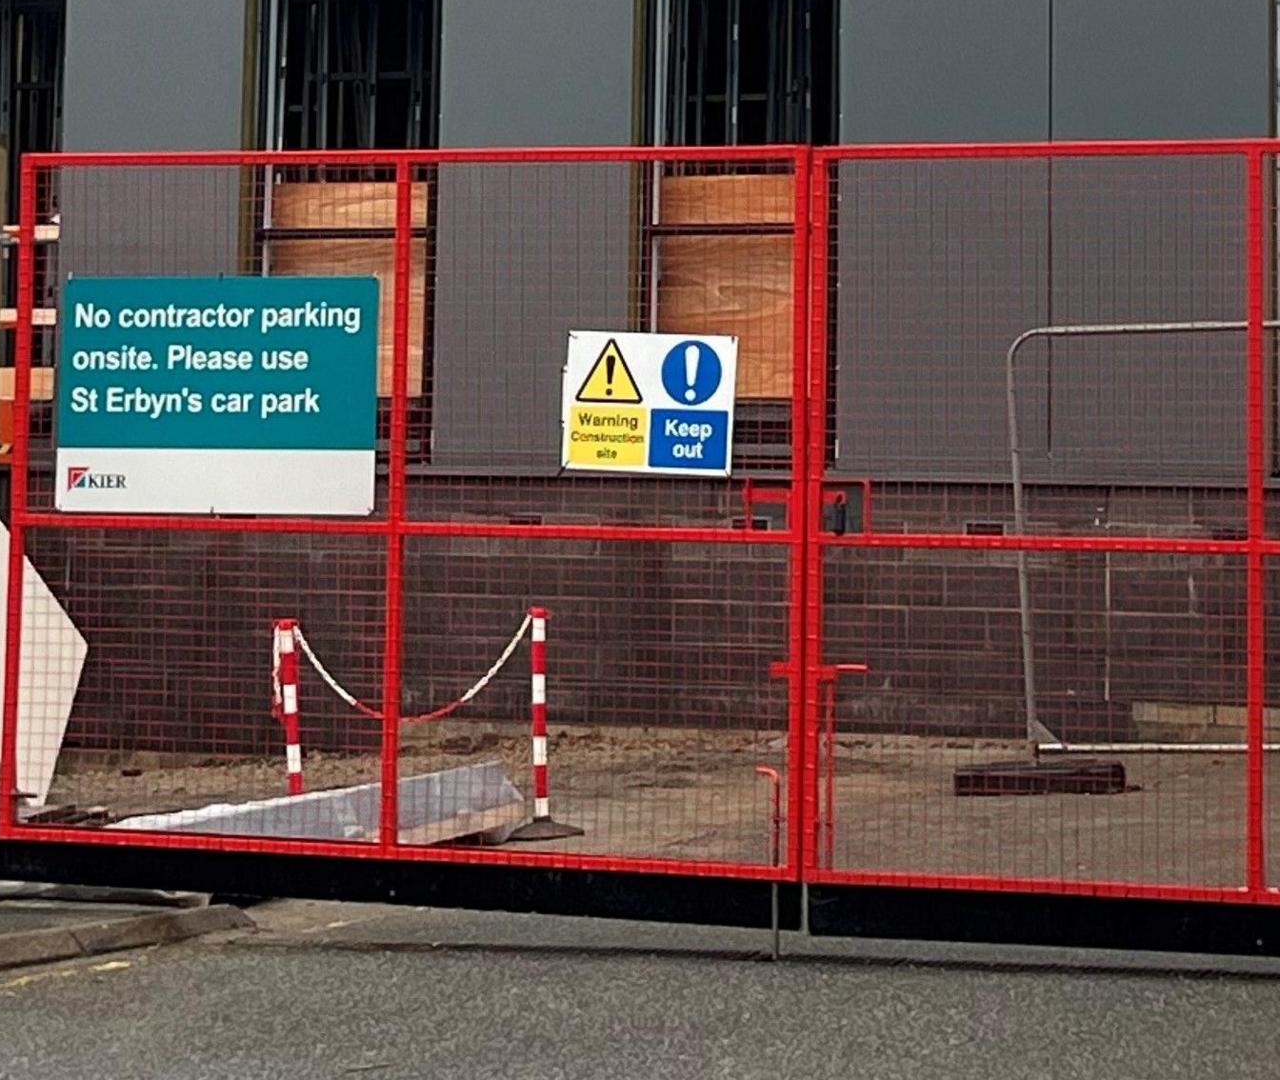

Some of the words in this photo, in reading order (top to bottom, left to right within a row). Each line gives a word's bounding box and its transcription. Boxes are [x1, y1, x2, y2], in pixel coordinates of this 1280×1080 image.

[75, 303, 110, 328] No
[119, 304, 254, 328] contractor
[261, 302, 361, 333] parking
[72, 346, 158, 370] onsite.
[168, 346, 253, 370] Please
[261, 351, 309, 370] use
[71, 387, 98, 412] St
[106, 387, 202, 419] Erbyn's
[210, 393, 254, 412] car
[261, 388, 320, 419] park
[578, 413, 639, 430] Warning
[571, 431, 644, 443] Construction
[665, 420, 712, 441] Keep
[596, 448, 617, 459] site
[673, 443, 703, 459] out
[88, 473, 127, 489] KIER
